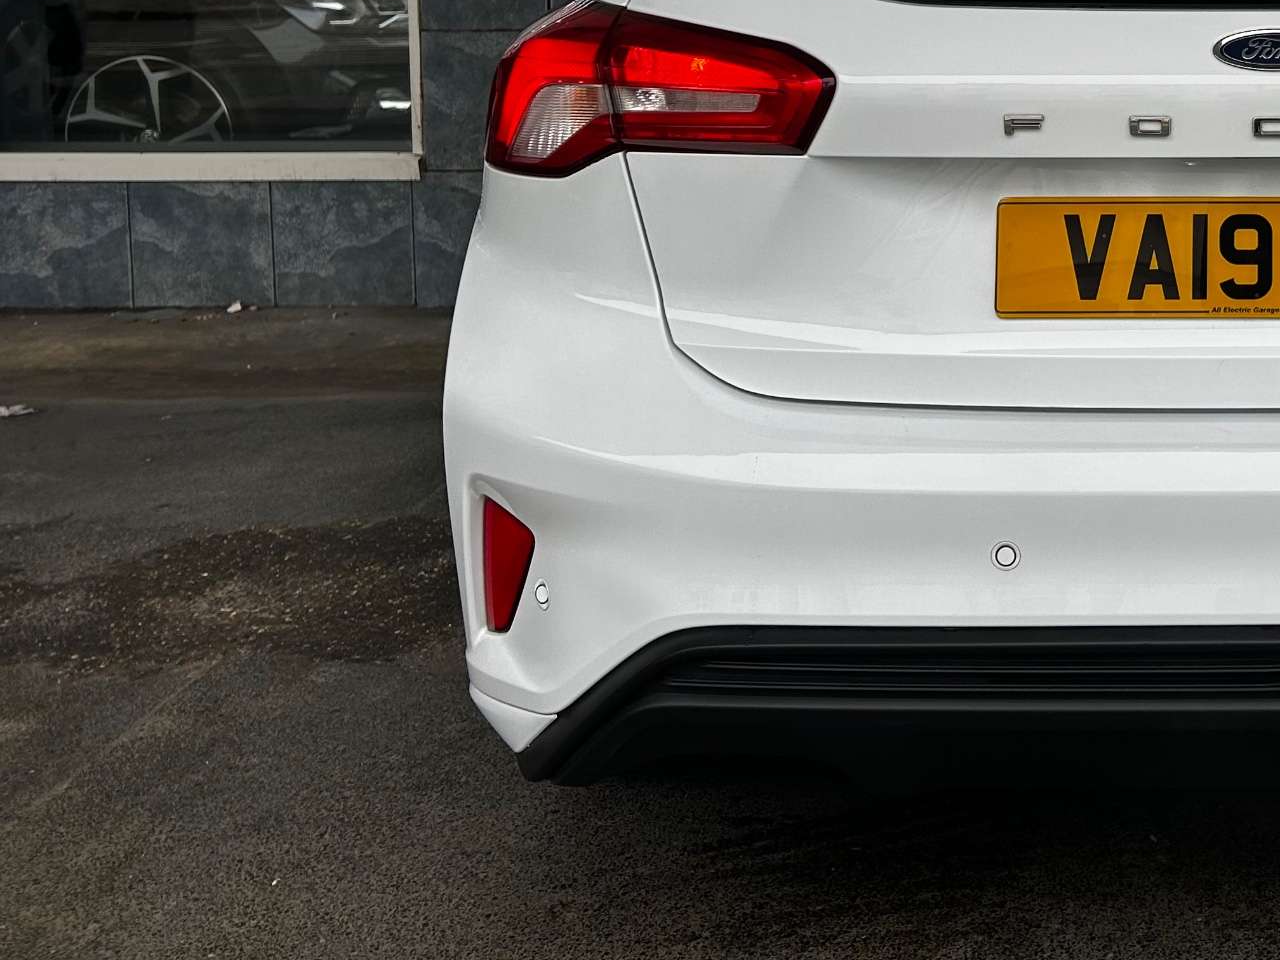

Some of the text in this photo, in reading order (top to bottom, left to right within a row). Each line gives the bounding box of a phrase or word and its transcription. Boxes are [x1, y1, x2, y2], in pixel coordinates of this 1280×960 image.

[1064, 213, 1274, 301] VA19
[1211, 306, 1222, 314] All
[1223, 306, 1250, 314] Electric
